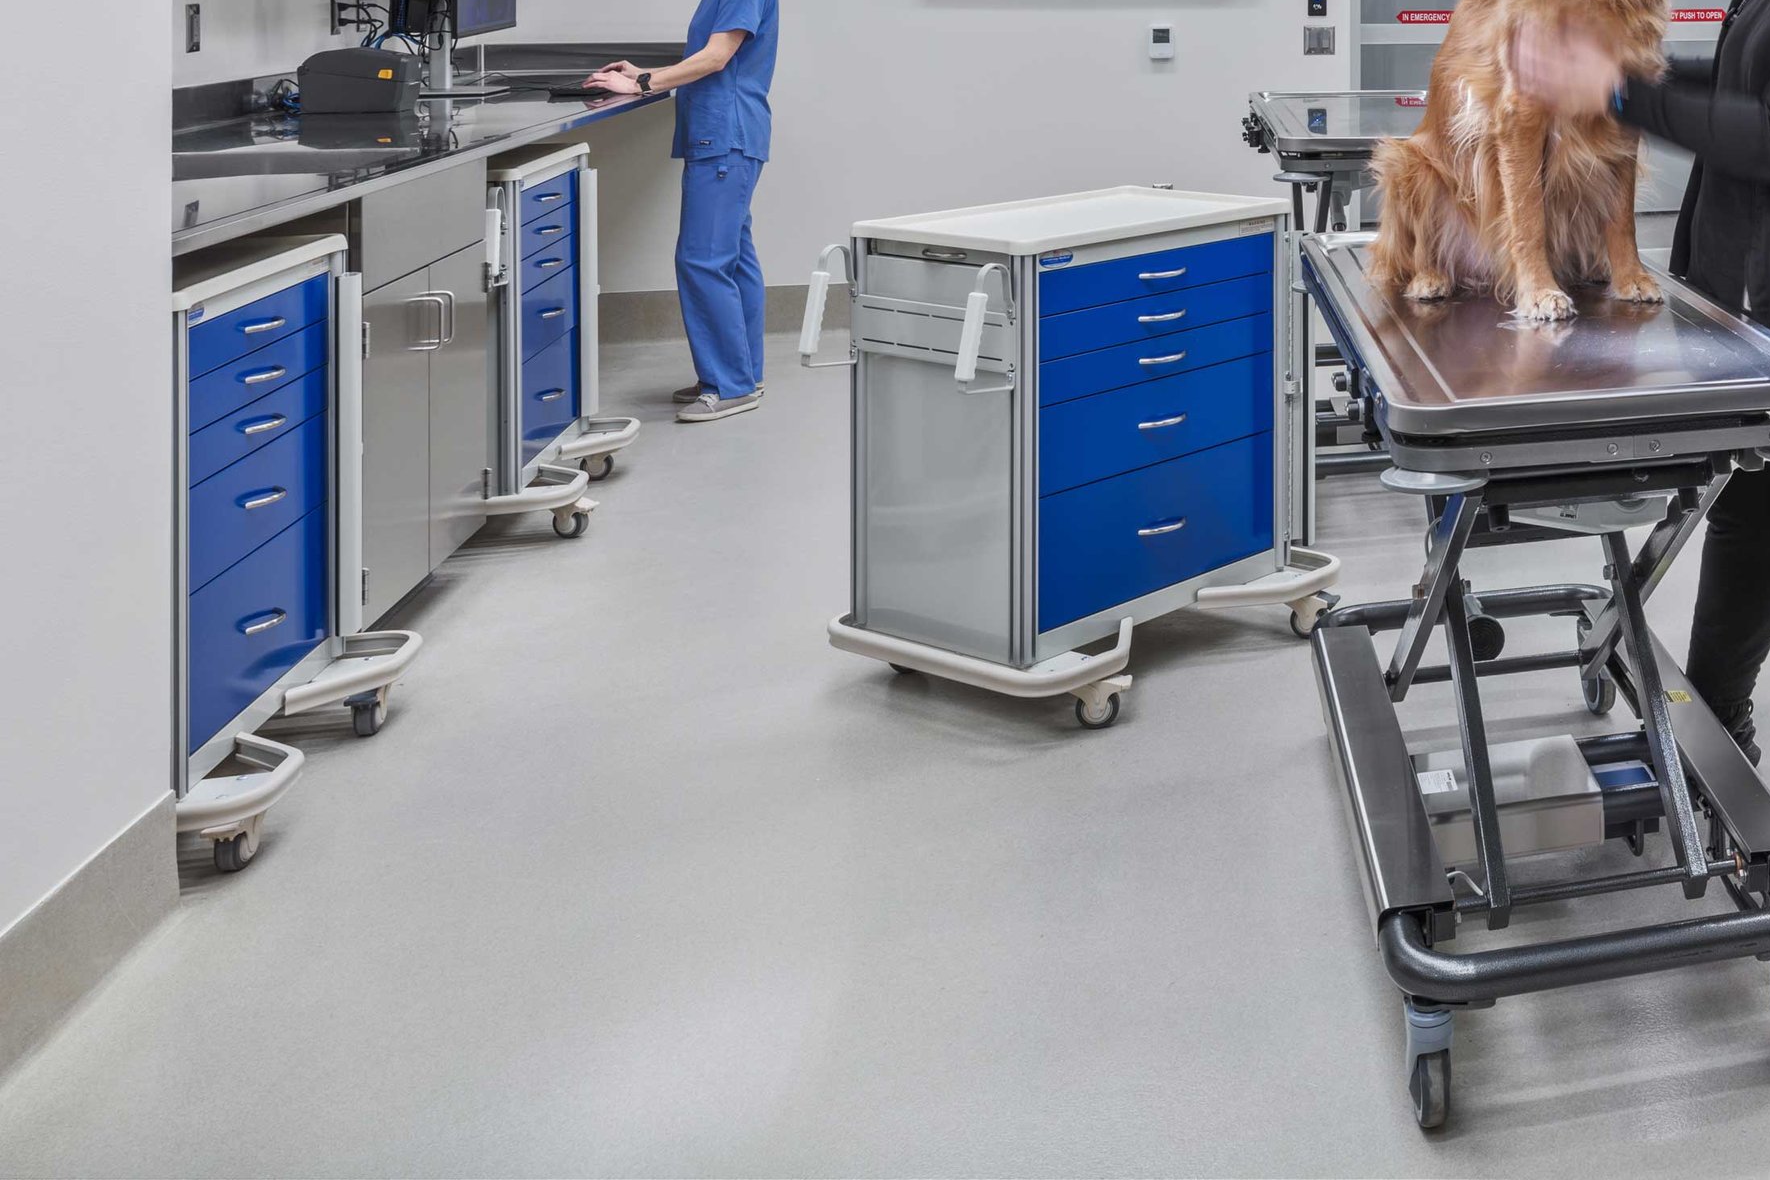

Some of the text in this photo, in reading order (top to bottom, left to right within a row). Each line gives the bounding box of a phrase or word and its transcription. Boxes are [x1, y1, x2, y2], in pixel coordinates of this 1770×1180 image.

[1402, 13, 1450, 21] IN EMERGENCY
[1680, 11, 1695, 19] PUSH
[1697, 11, 1704, 19] TO
[1706, 11, 1722, 19] OPEN
